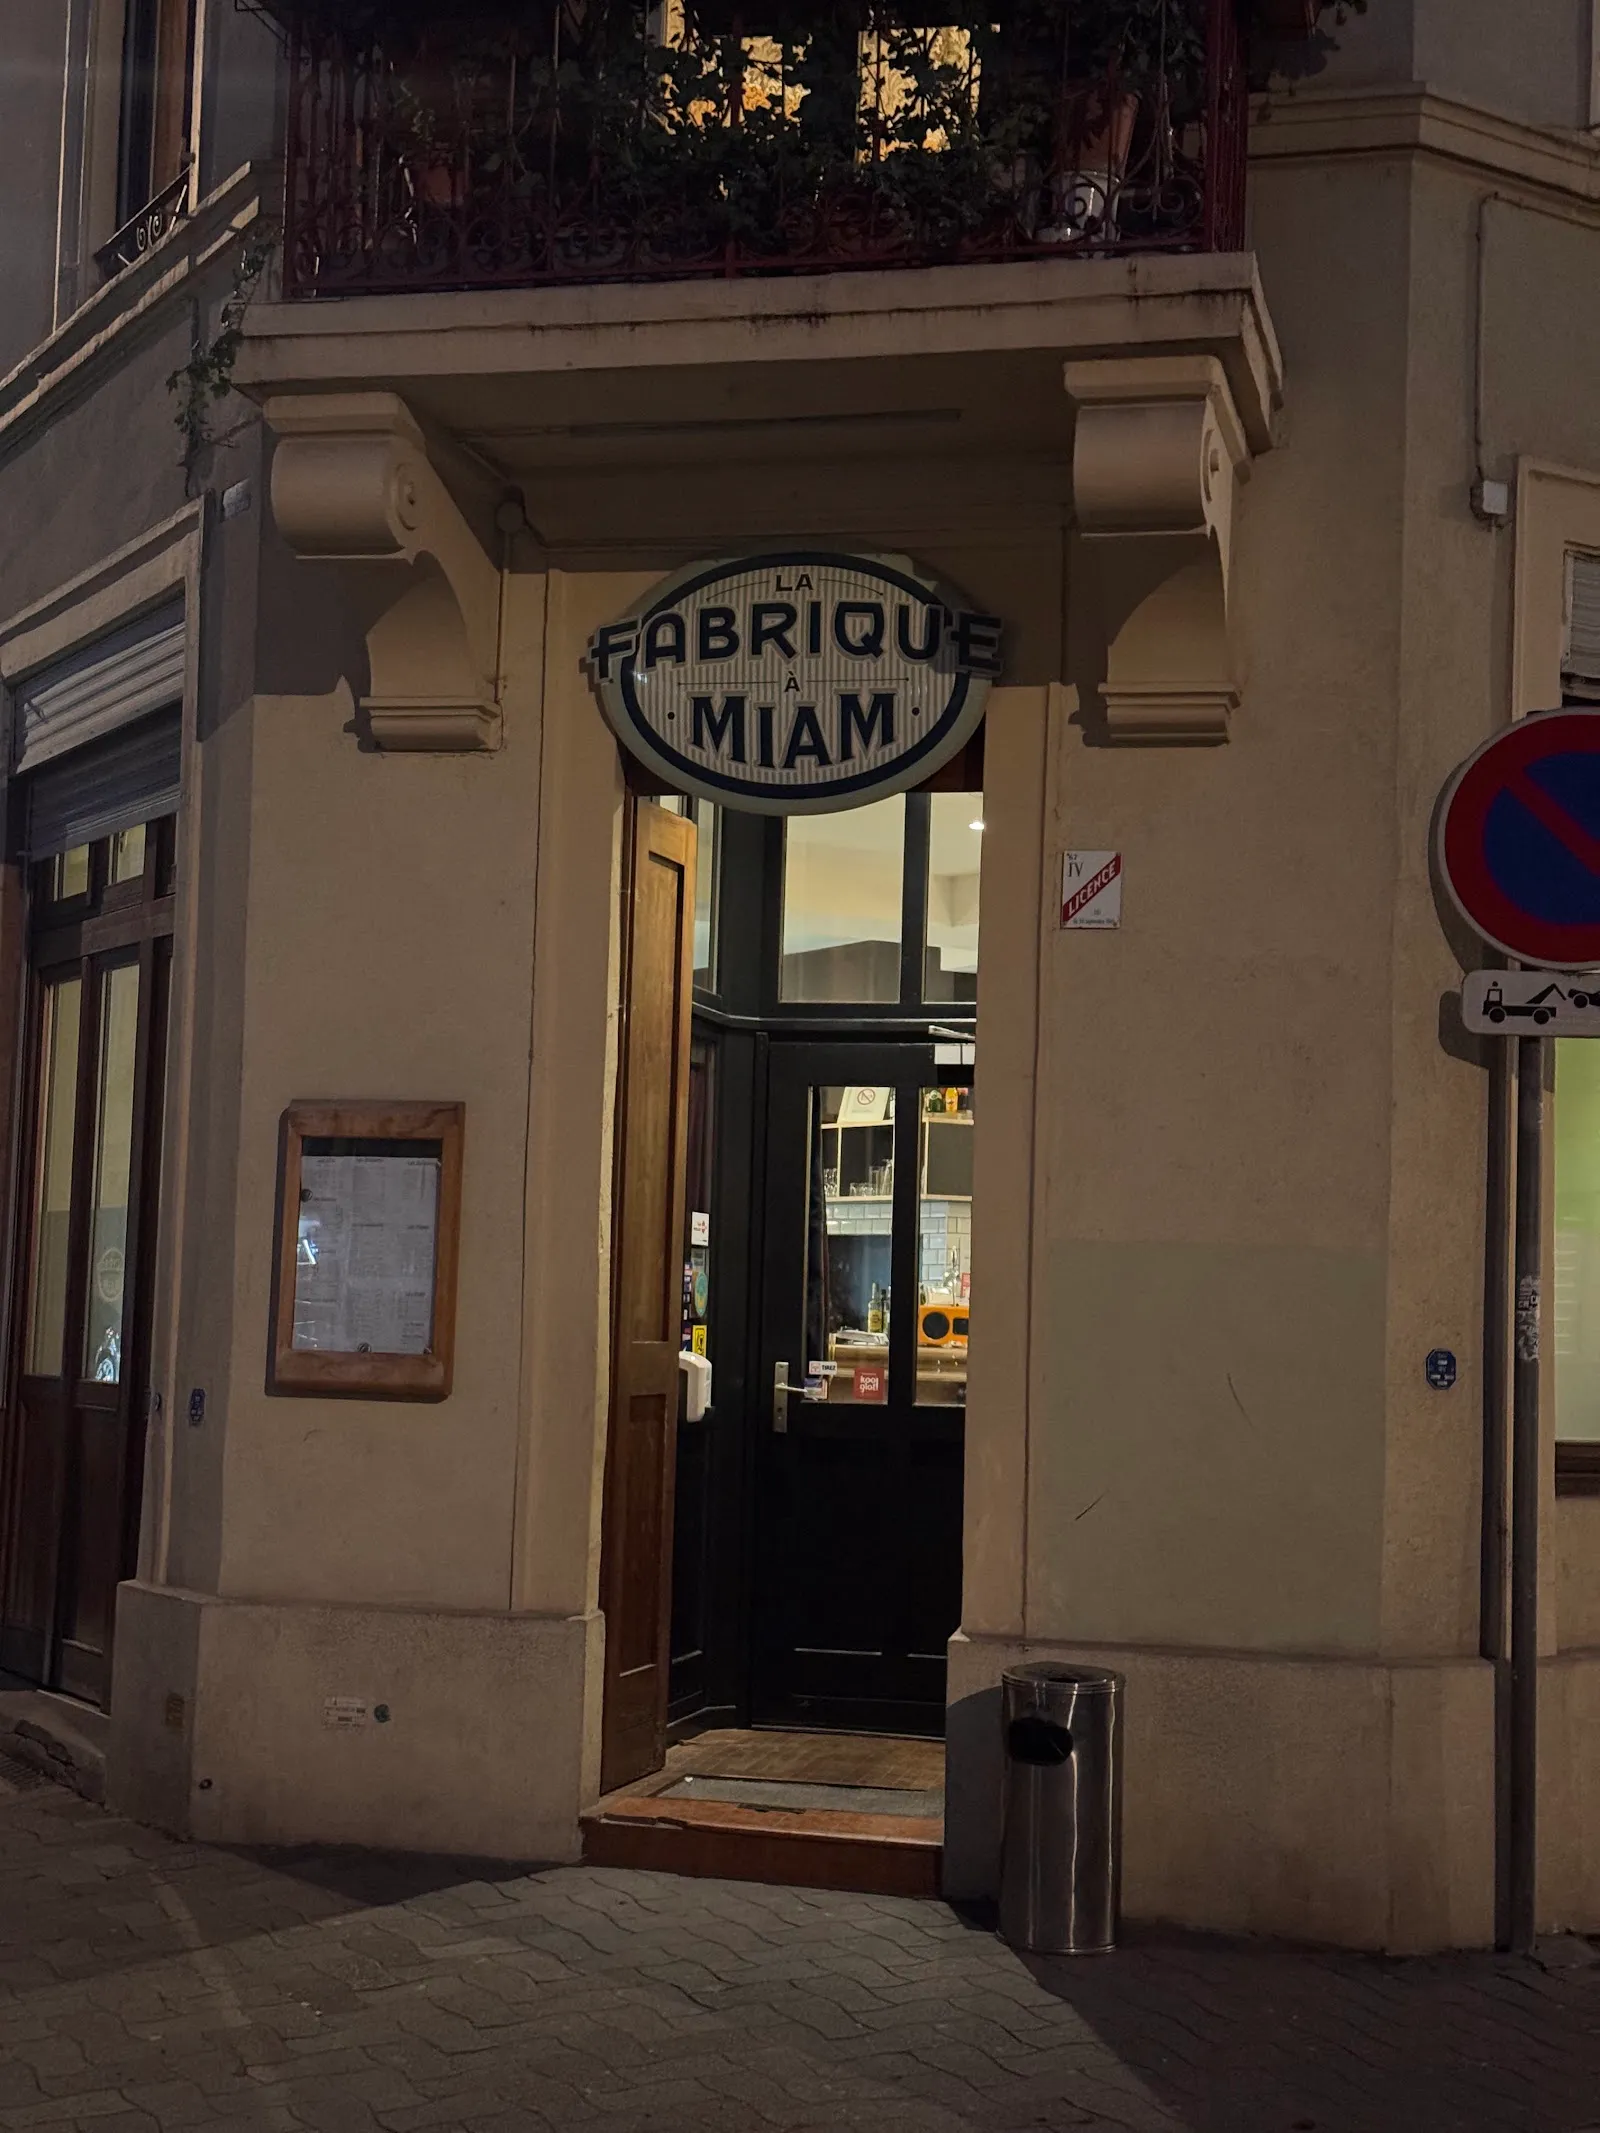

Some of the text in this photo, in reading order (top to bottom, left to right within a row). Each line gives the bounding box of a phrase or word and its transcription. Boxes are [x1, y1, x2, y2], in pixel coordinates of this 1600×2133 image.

[774, 574, 814, 592] LA
[591, 601, 1002, 678] FABRIQUE
[784, 671, 801, 693] À
[691, 693, 896, 769] MIAM
[1068, 861, 1084, 877] IV
[1068, 860, 1116, 917] LICENCE
